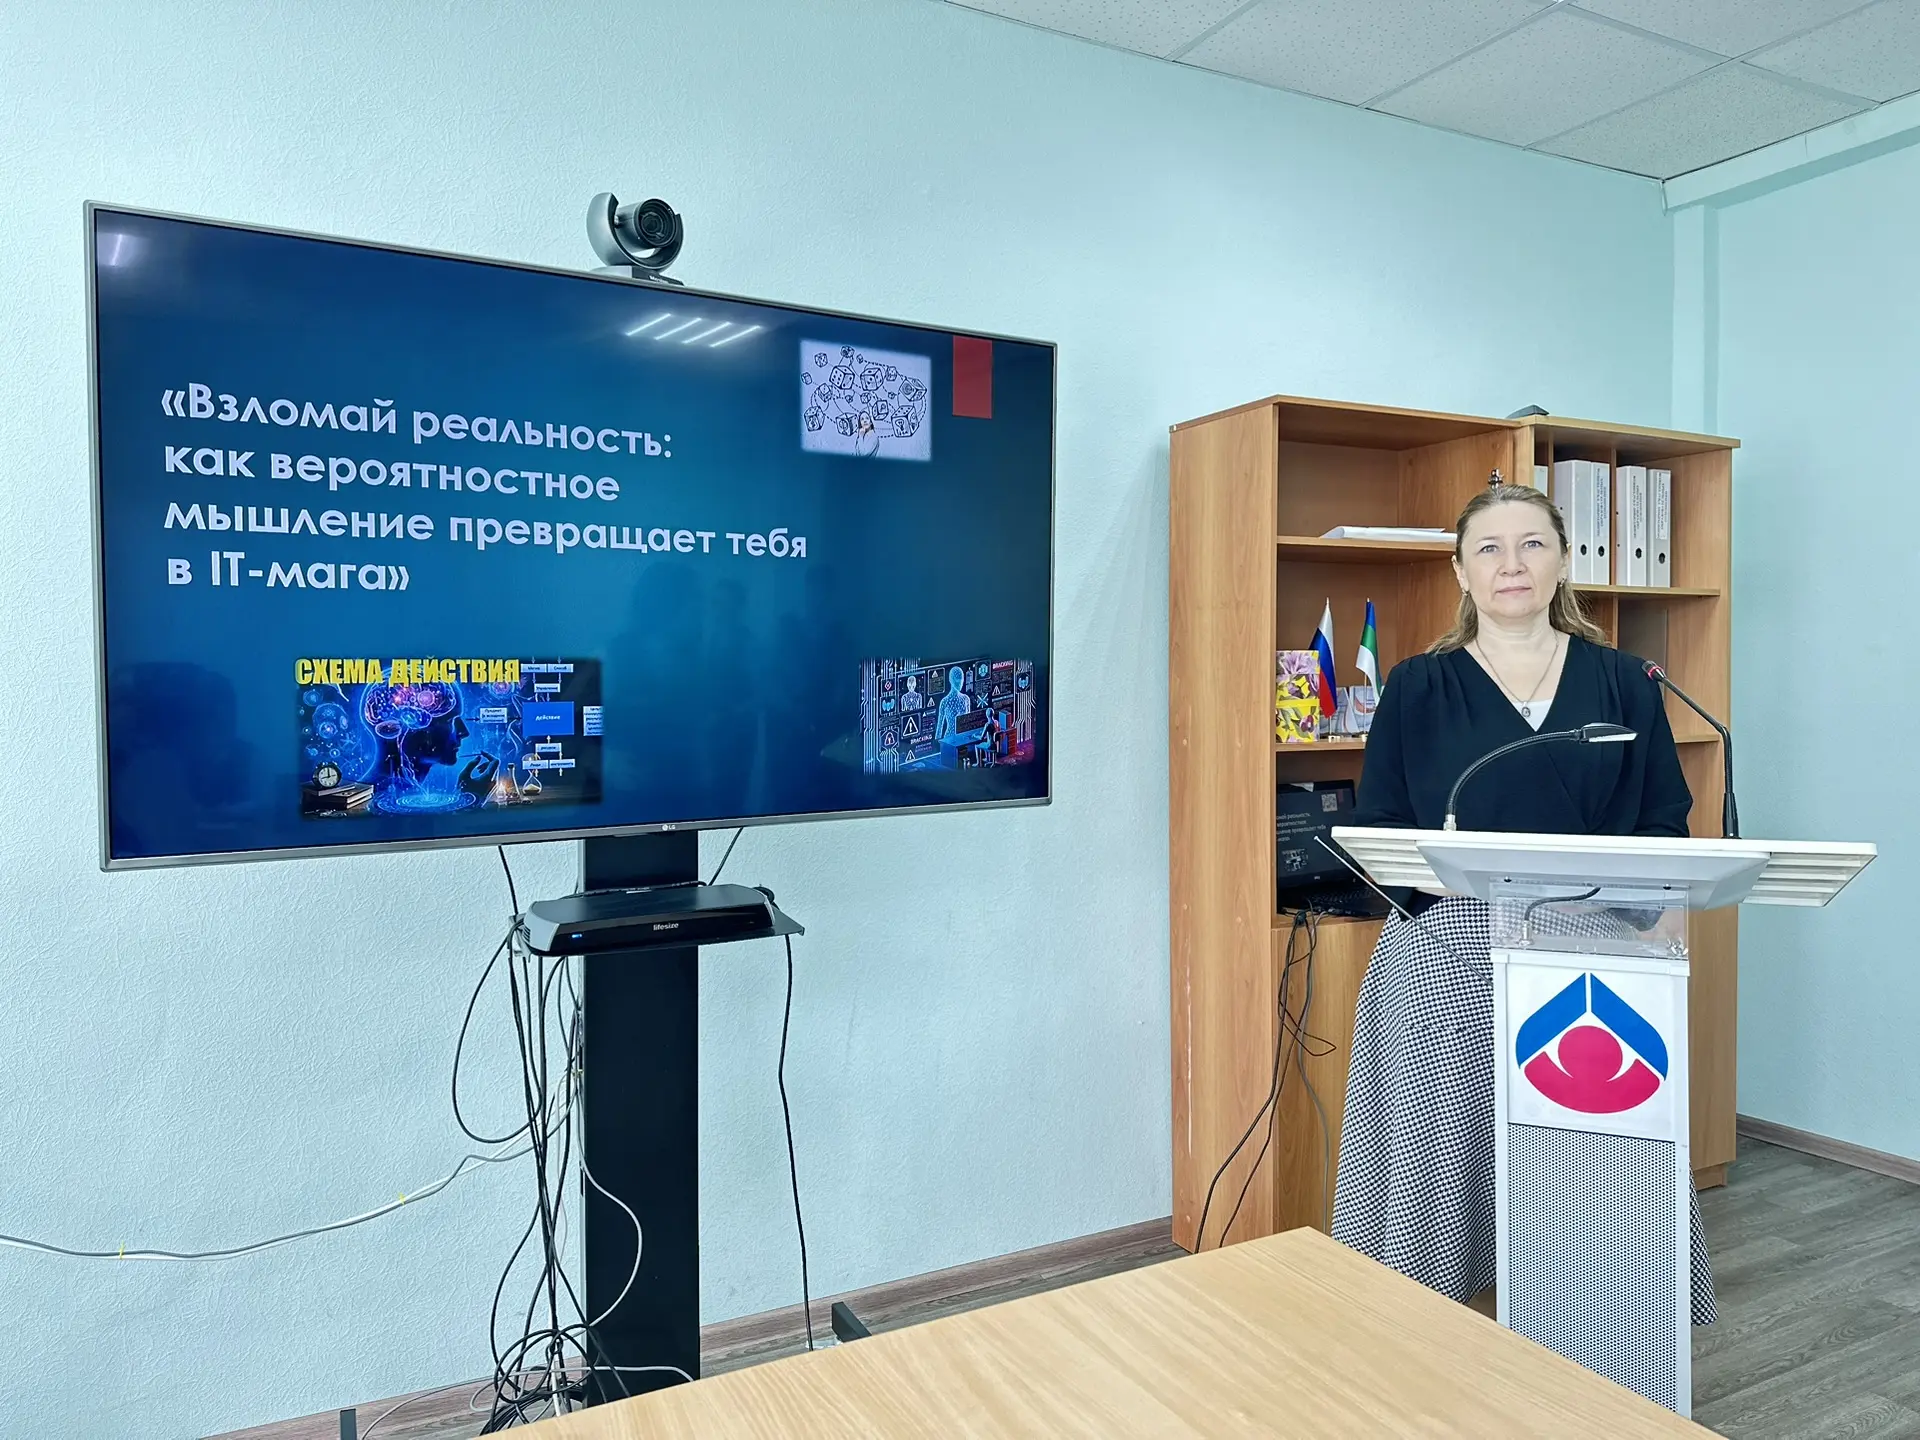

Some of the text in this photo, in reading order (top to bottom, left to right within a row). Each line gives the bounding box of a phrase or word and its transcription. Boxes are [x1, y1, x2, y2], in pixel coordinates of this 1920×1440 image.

[161, 382, 672, 458] «Взломай реальность:
[165, 445, 620, 501] как вероятностное
[163, 502, 807, 559] мышление превращает тебя
[167, 550, 410, 591] в IT-мага»
[295, 656, 520, 687] СХЕМА ДЕЙСТВИЯ
[653, 922, 679, 931] lifesize
